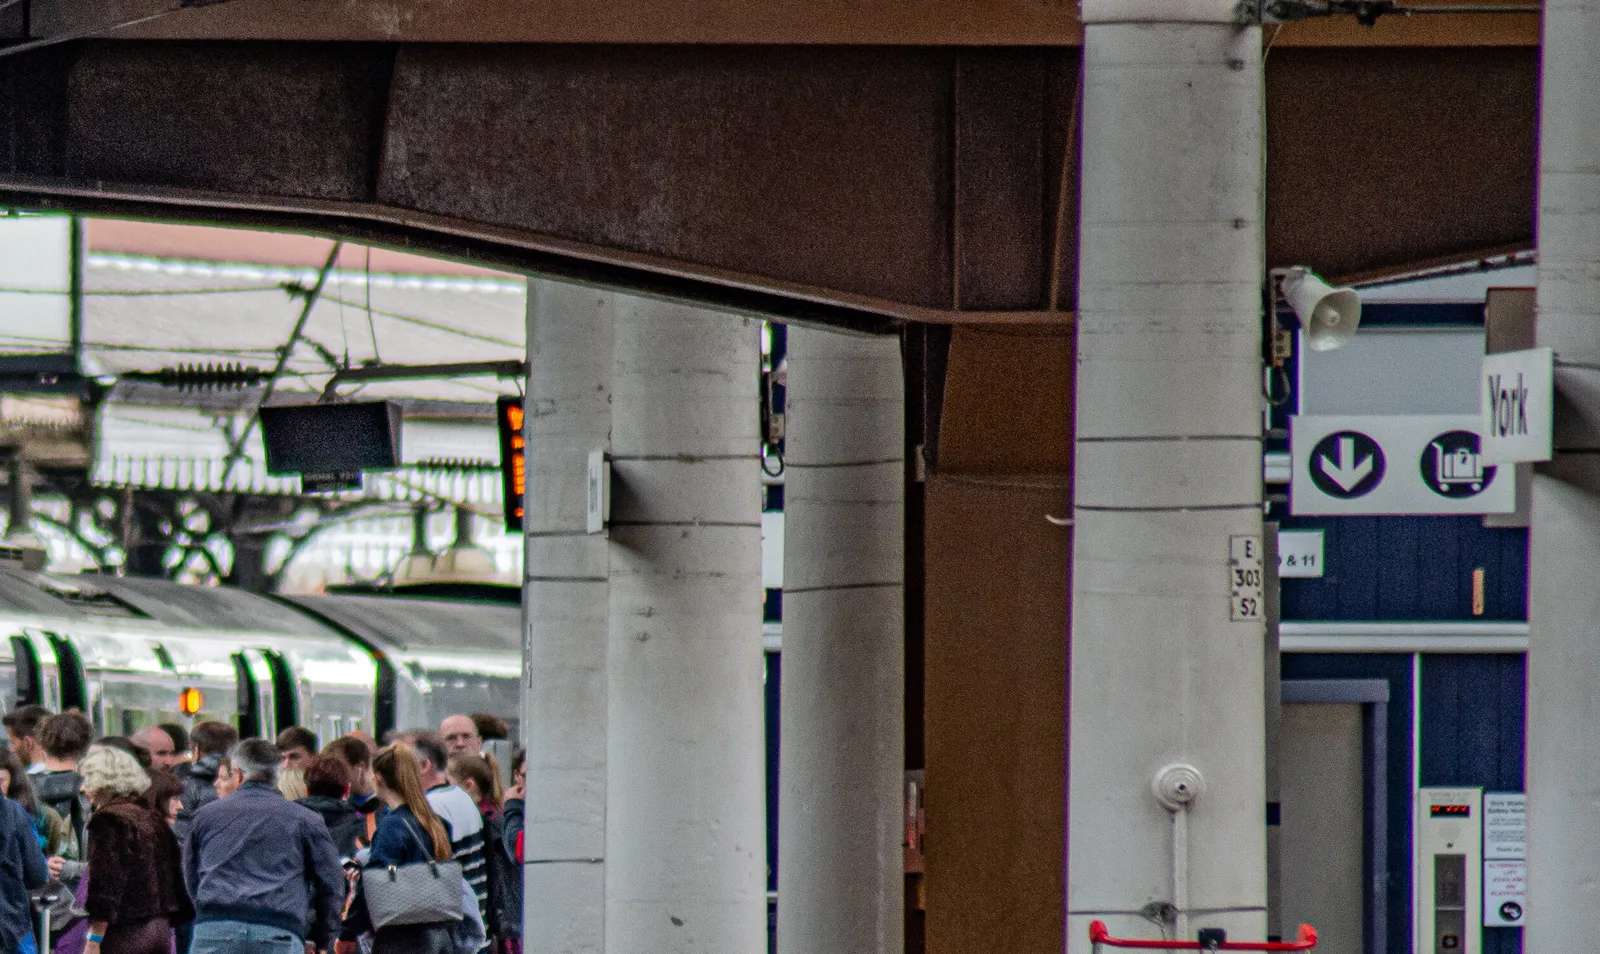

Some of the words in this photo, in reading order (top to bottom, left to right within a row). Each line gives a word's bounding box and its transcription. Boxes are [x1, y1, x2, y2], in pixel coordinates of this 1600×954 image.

[1488, 372, 1528, 437] York
[1245, 540, 1253, 558] E
[1302, 554, 1315, 567] 11
[1235, 568, 1260, 588] 303
